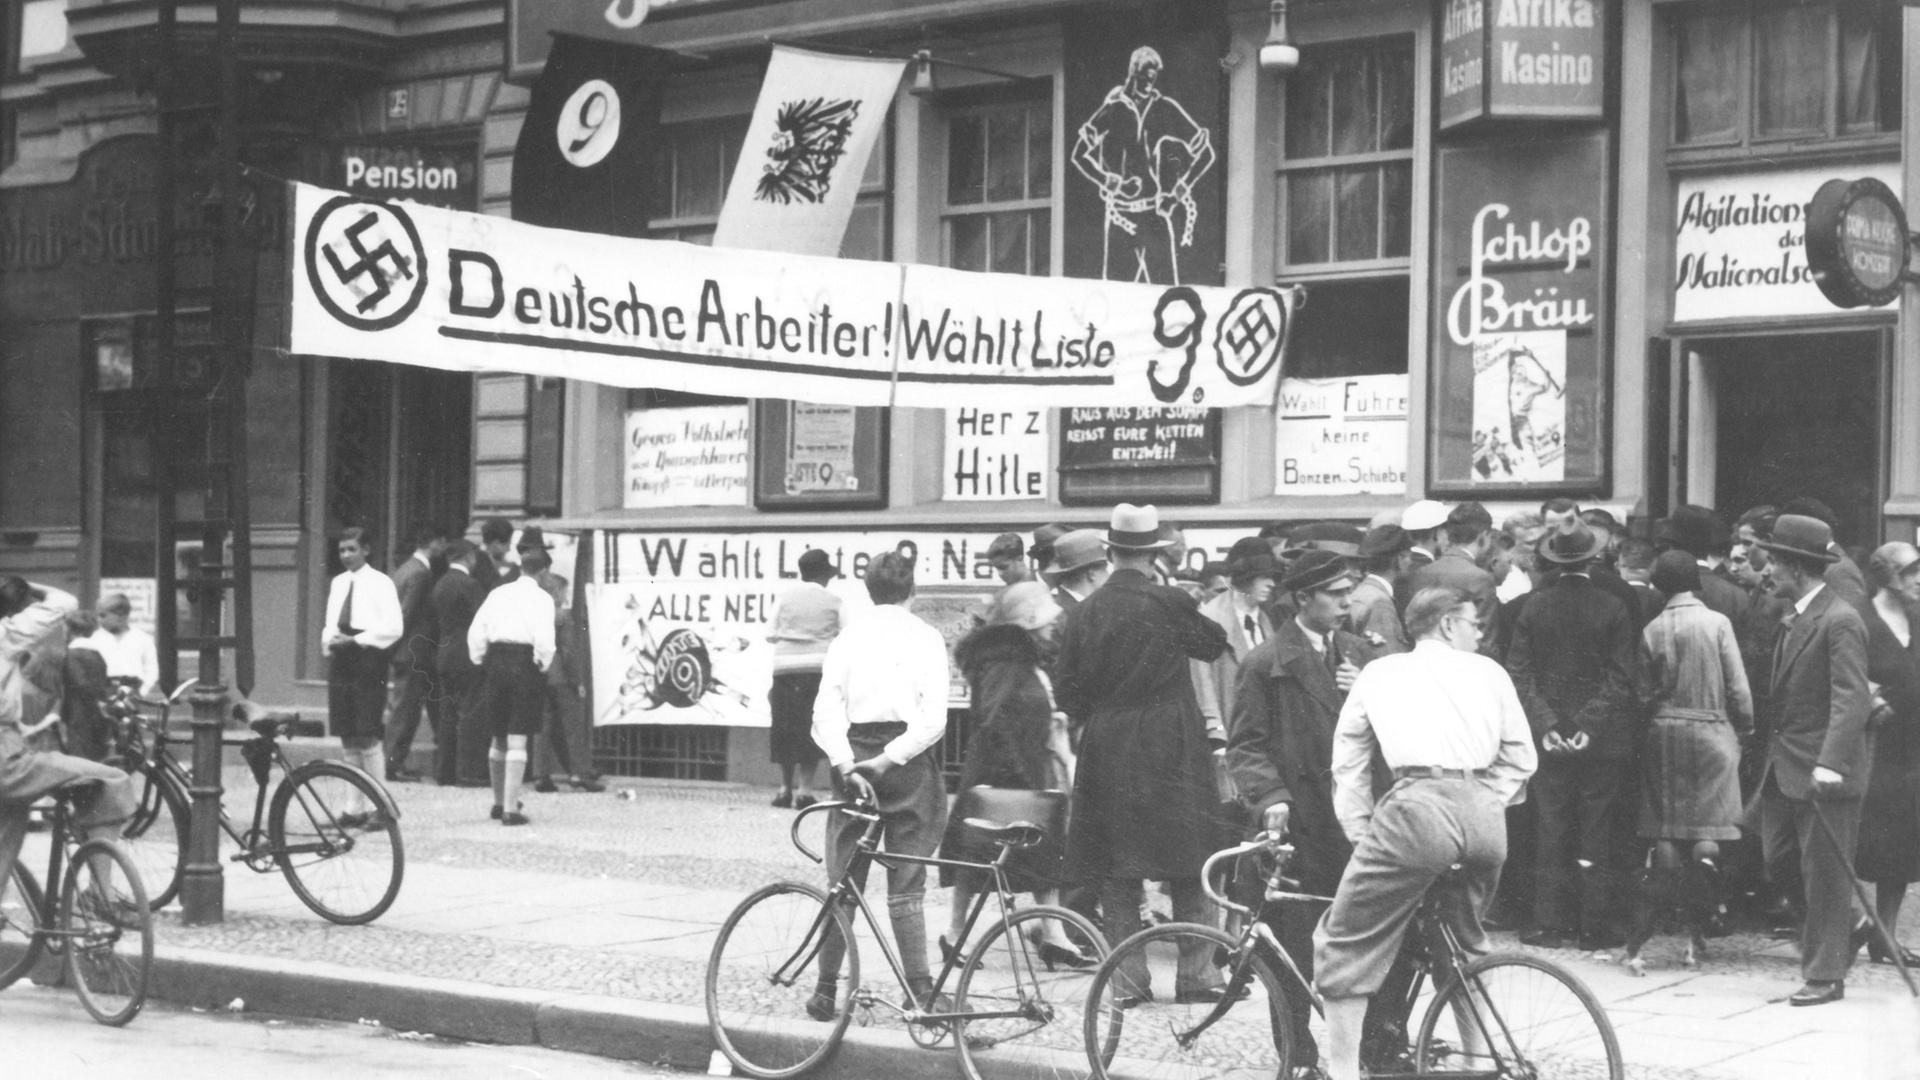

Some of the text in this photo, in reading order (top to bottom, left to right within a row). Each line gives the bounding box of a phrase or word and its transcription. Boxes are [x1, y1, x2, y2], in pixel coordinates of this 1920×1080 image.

[1443, 48, 1483, 98] Kasino
[1501, 40, 1594, 84] Kasino
[568, 91, 604, 153] 9
[346, 157, 458, 189] Pension
[1471, 203, 1591, 274] Schloß
[448, 247, 686, 342] Deutsche
[696, 278, 893, 359] Arbeiter!
[902, 303, 1022, 368] Wählt
[1031, 309, 1115, 368] Liste
[1447, 277, 1594, 346] Bräu
[1113, 427, 1148, 441] EURE
[1321, 427, 1370, 443] keine
[779, 540, 869, 580] Lte
[649, 595, 711, 622] ALLE
